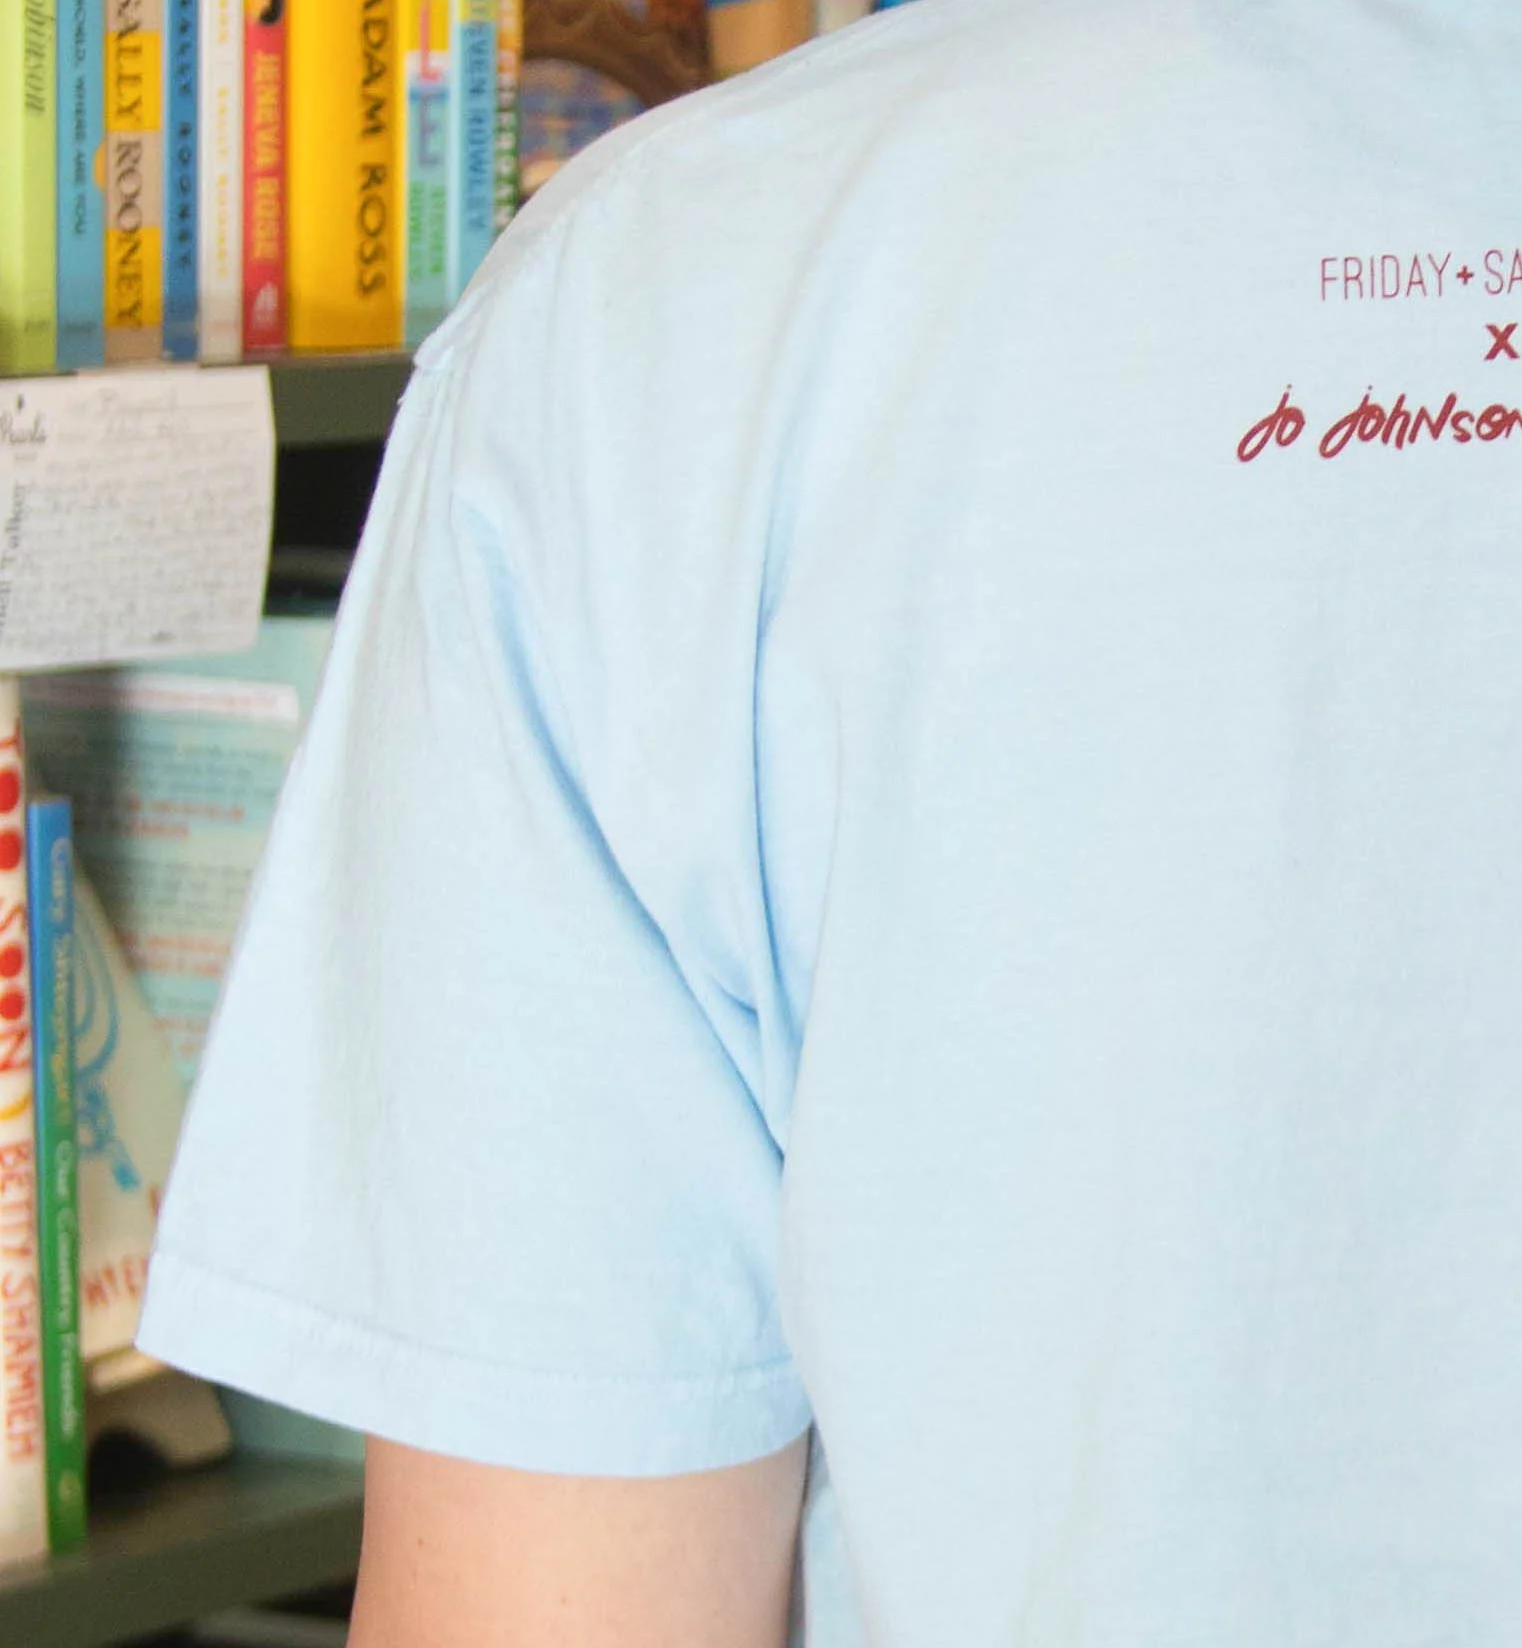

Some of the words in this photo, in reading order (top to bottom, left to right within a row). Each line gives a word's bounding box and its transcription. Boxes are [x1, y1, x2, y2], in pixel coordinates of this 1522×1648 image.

[74, 72, 88, 144] WHERE
[252, 52, 282, 168] JENEVA
[74, 150, 88, 188] ARE
[74, 194, 88, 237] YOU
[176, 120, 195, 270] ROONEY
[252, 175, 281, 260] ROSE
[465, 108, 490, 231] ROWLEY
[112, 142, 144, 328] ROONEY
[355, 162, 387, 299] ROSS
